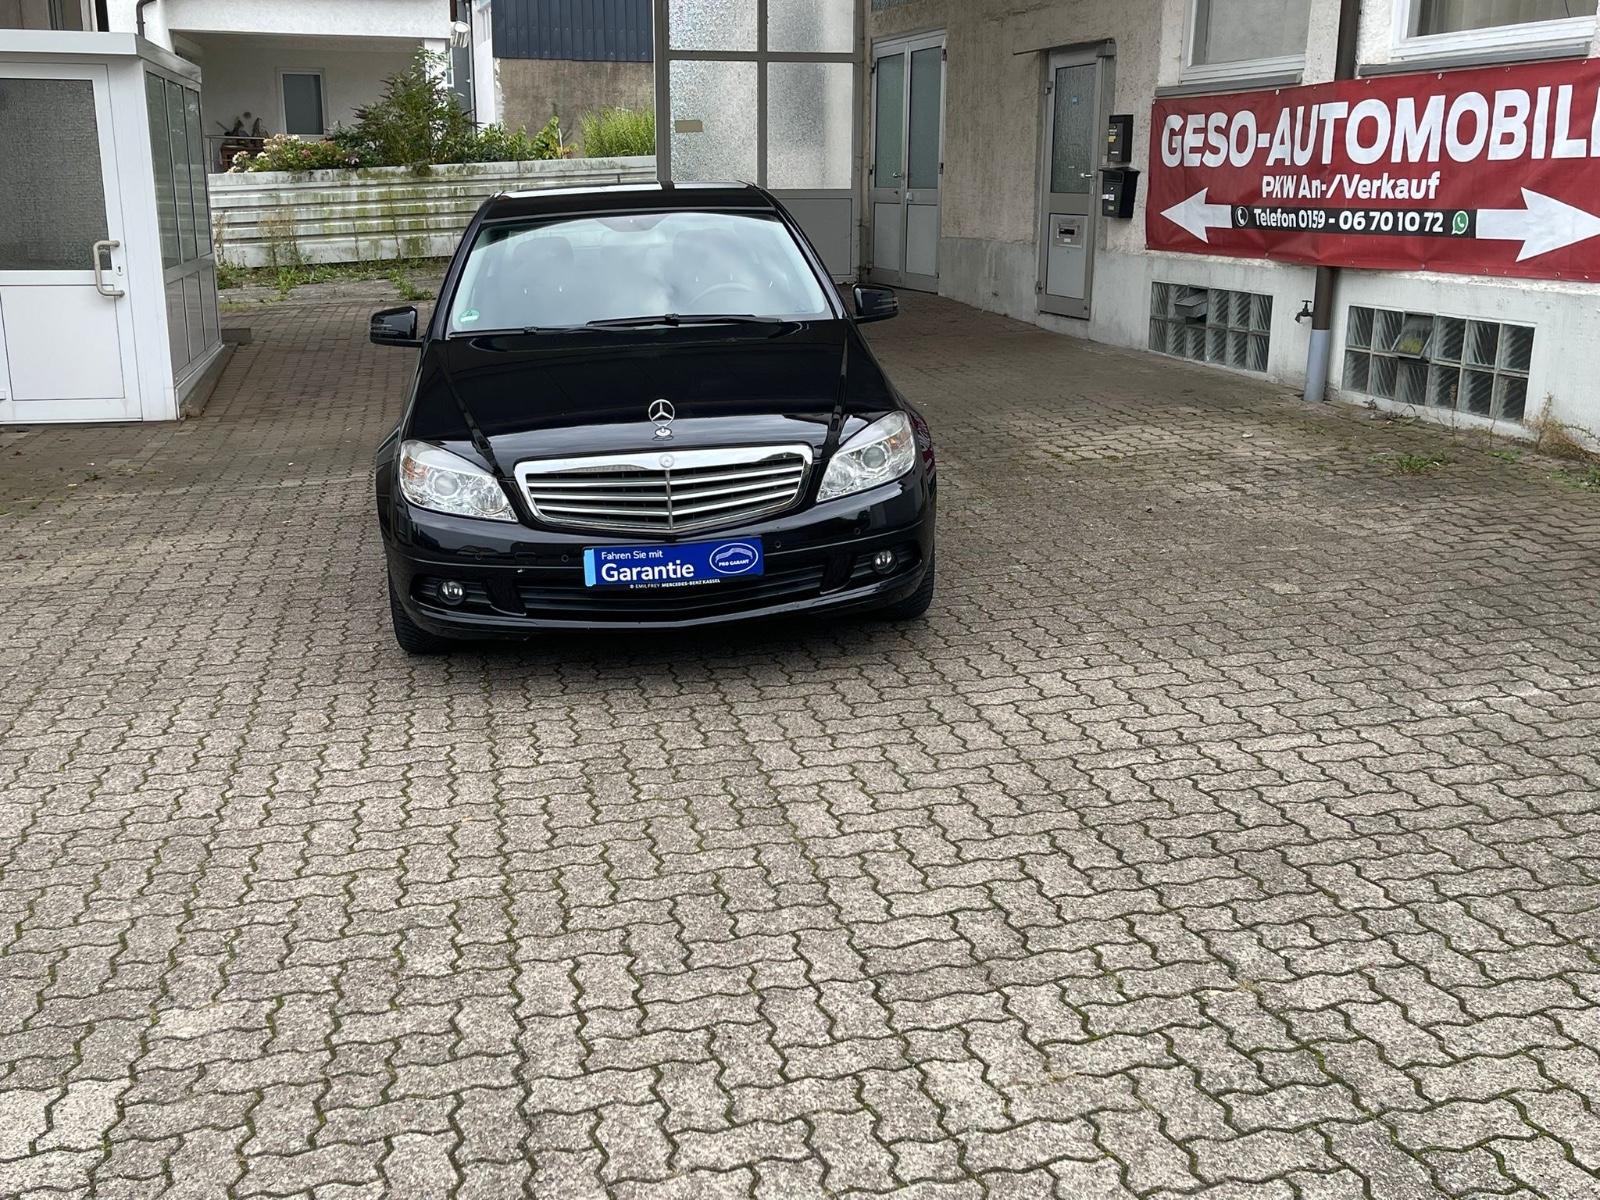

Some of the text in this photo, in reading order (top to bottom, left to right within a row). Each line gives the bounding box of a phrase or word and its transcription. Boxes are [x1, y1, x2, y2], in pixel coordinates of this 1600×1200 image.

[1262, 171, 1440, 200] PKW An-/Verkauf
[1254, 208, 1296, 228] Telefon
[1299, 210, 1325, 228] 0159
[1424, 212, 1443, 232] 72
[601, 550, 663, 560] Fahren Sie mit
[602, 560, 694, 581] Garantie
